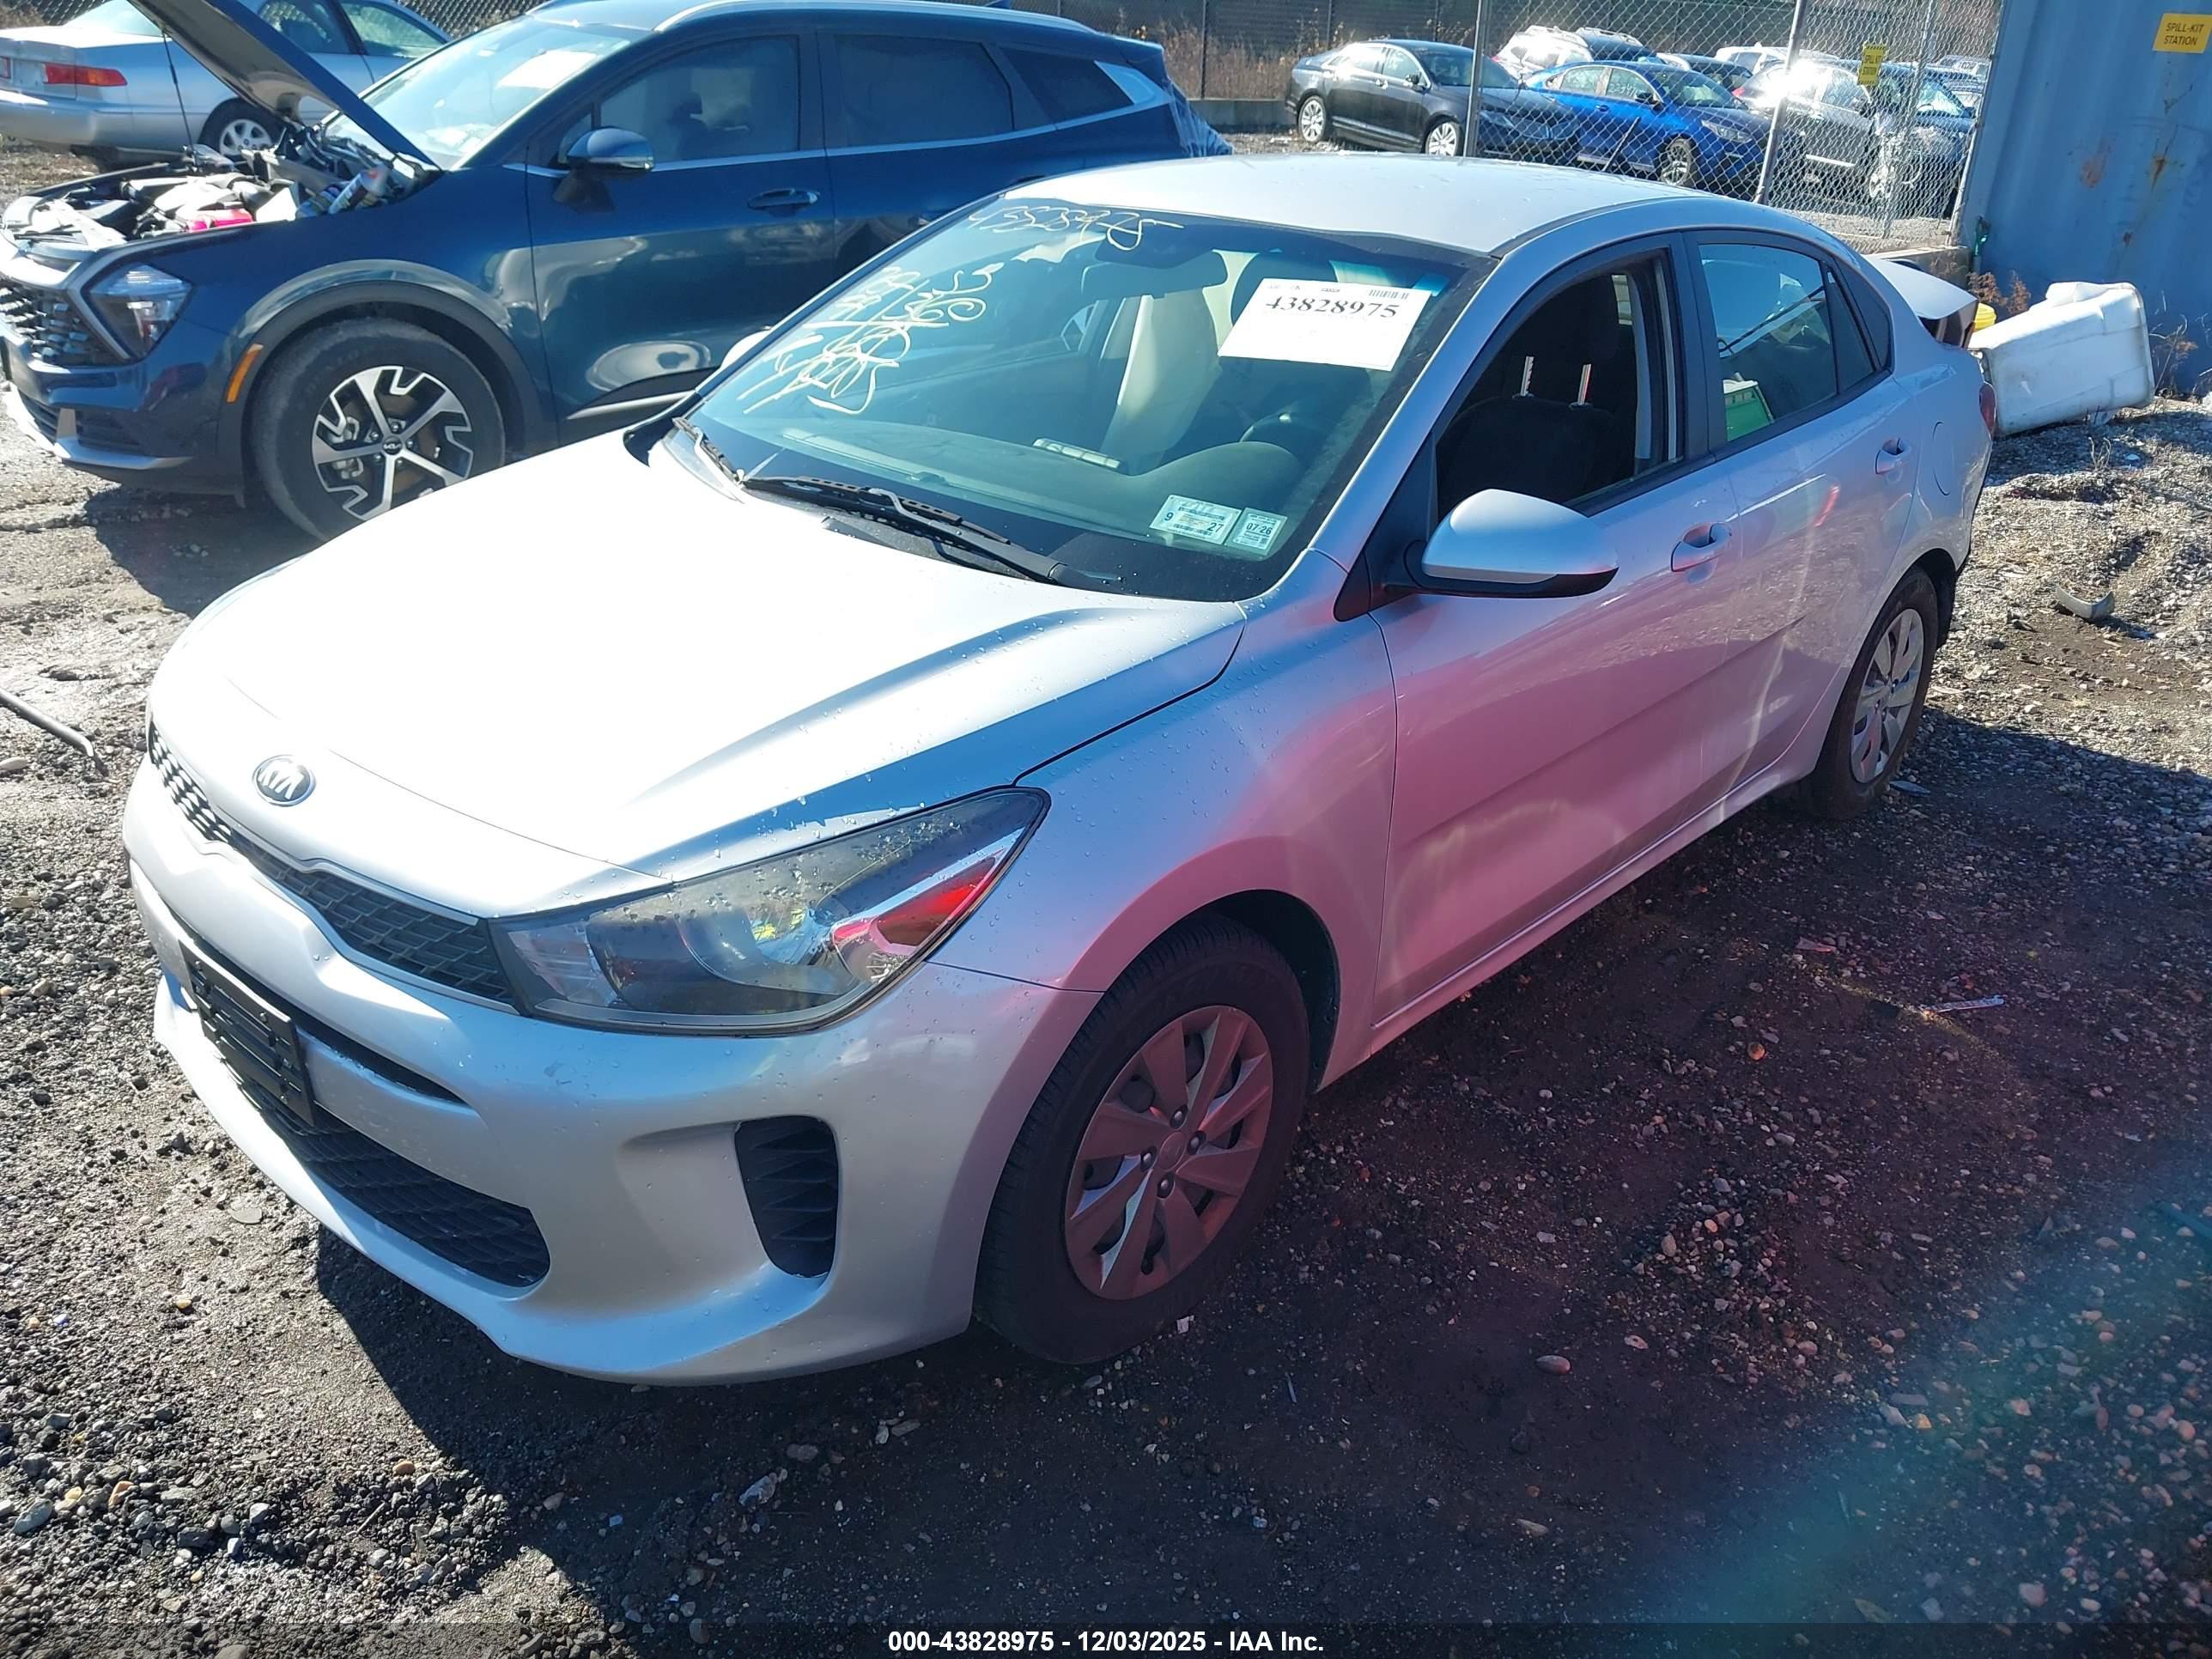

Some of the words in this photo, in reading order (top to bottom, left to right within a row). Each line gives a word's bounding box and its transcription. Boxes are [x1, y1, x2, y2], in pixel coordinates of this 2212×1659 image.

[2166, 22, 2204, 33] SPILL-KIT
[2164, 35, 2197, 46] STATION
[1265, 295, 1402, 319] 43828975
[1164, 512, 1174, 521] 9
[1206, 522, 1224, 532] 27
